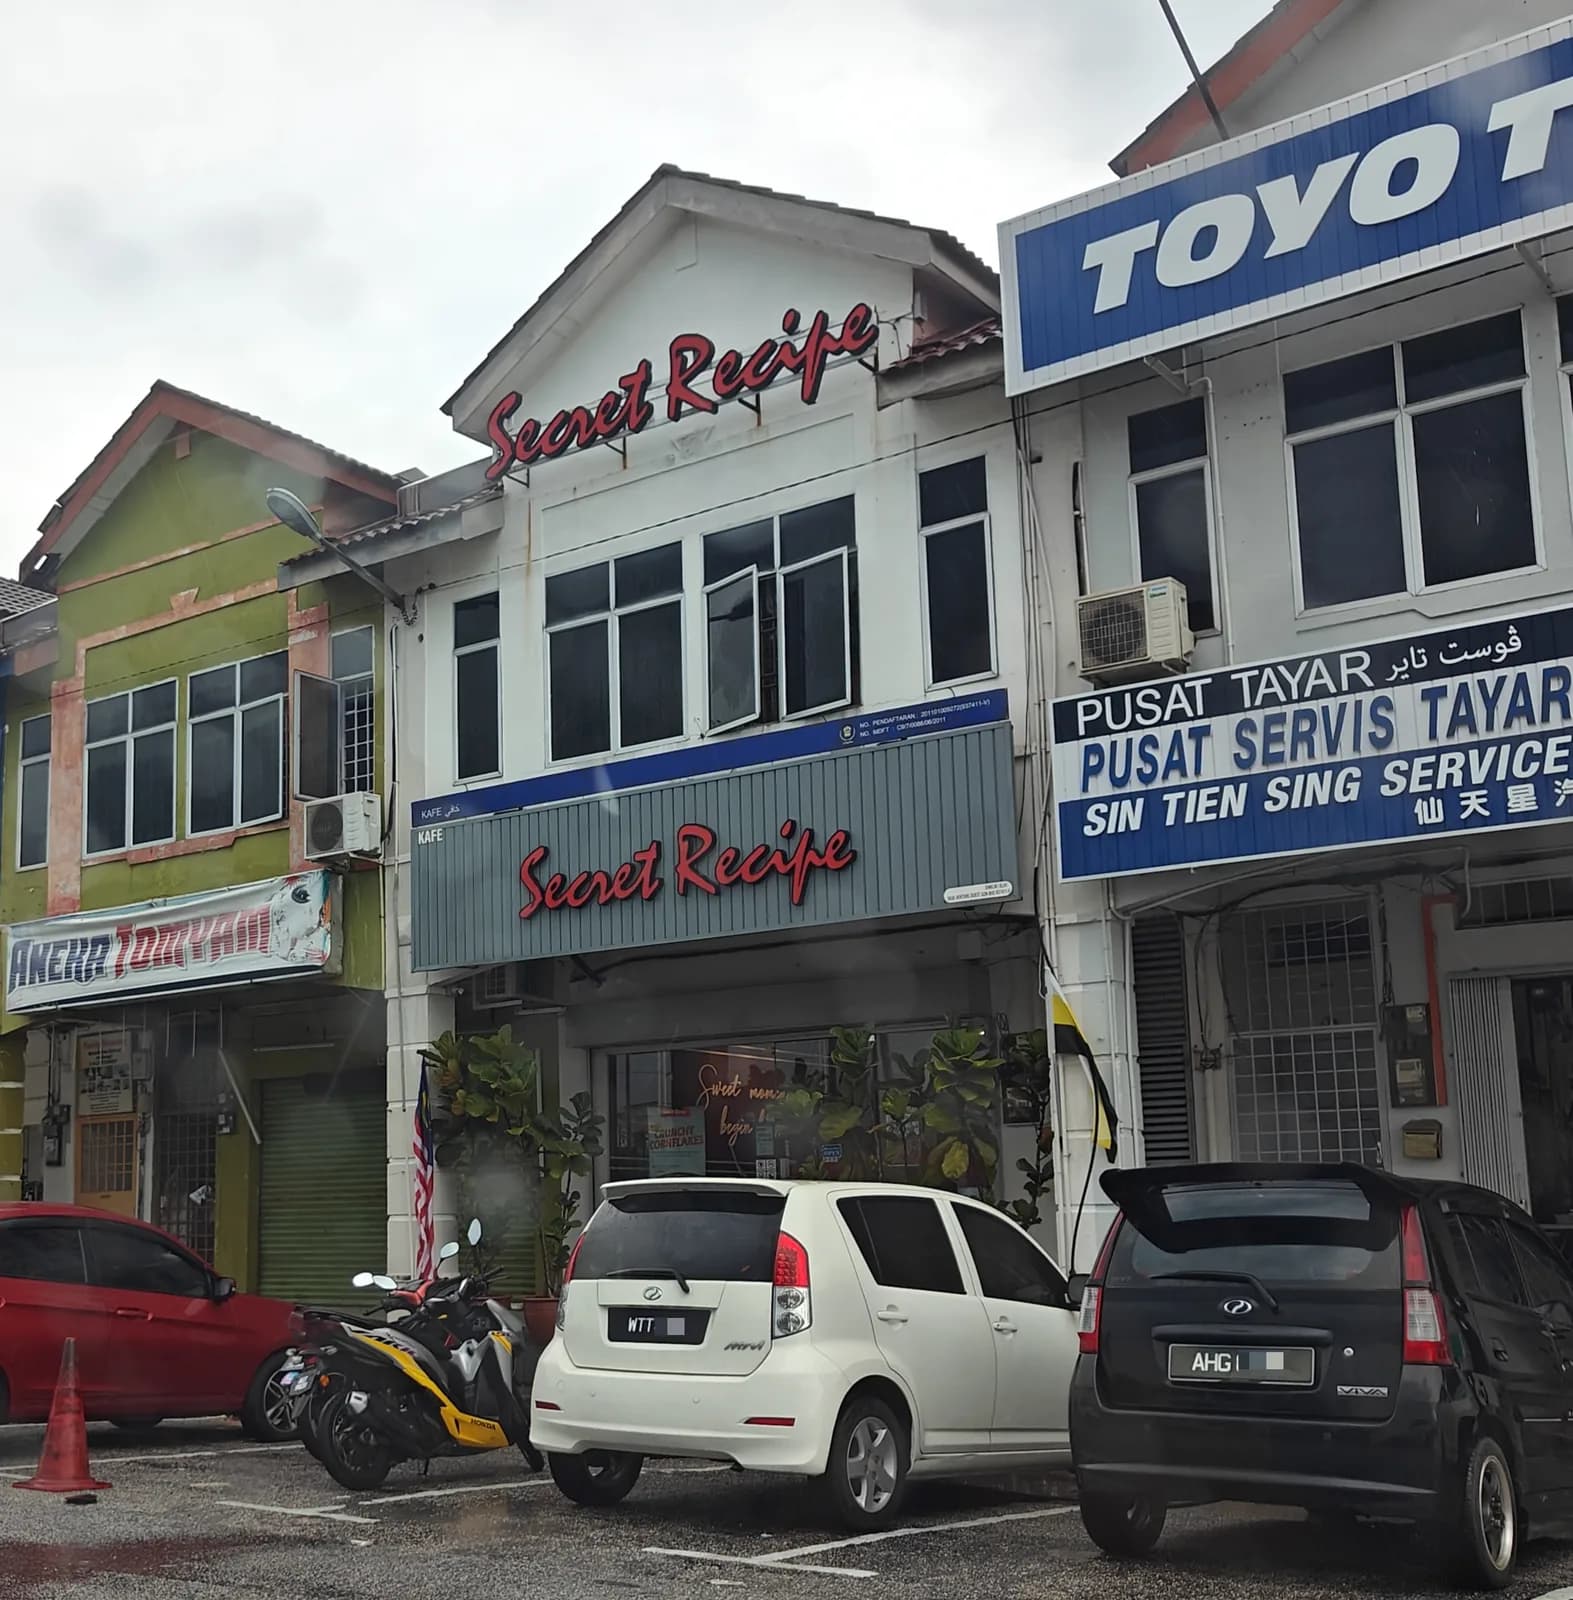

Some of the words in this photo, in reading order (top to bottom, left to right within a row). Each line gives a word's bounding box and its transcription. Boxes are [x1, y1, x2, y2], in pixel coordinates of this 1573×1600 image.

[1082, 123, 1460, 314] TOYO
[485, 359, 654, 481] Secret
[665, 302, 880, 423] Recipe
[1077, 678, 1212, 736] PUSAT
[1231, 650, 1374, 708] TAYAR
[1082, 724, 1212, 793] PUSAT
[1232, 694, 1396, 770] SERVIS
[1420, 665, 1573, 741] TAYAR
[421, 806, 442, 819] KAFE
[1083, 797, 1144, 837] SIN
[1162, 782, 1248, 826] TIEN
[1263, 766, 1362, 812] SING
[1380, 734, 1573, 797] SERVICE
[418, 828, 443, 845] KAFE
[518, 845, 663, 920] Secret
[675, 819, 857, 905] Recipe
[8, 933, 113, 994] ANEKA
[696, 1064, 741, 1109] Sweet
[627, 1317, 655, 1333] WTT
[1191, 1352, 1232, 1372] AHG
[1337, 1386, 1388, 1397] VIVA
